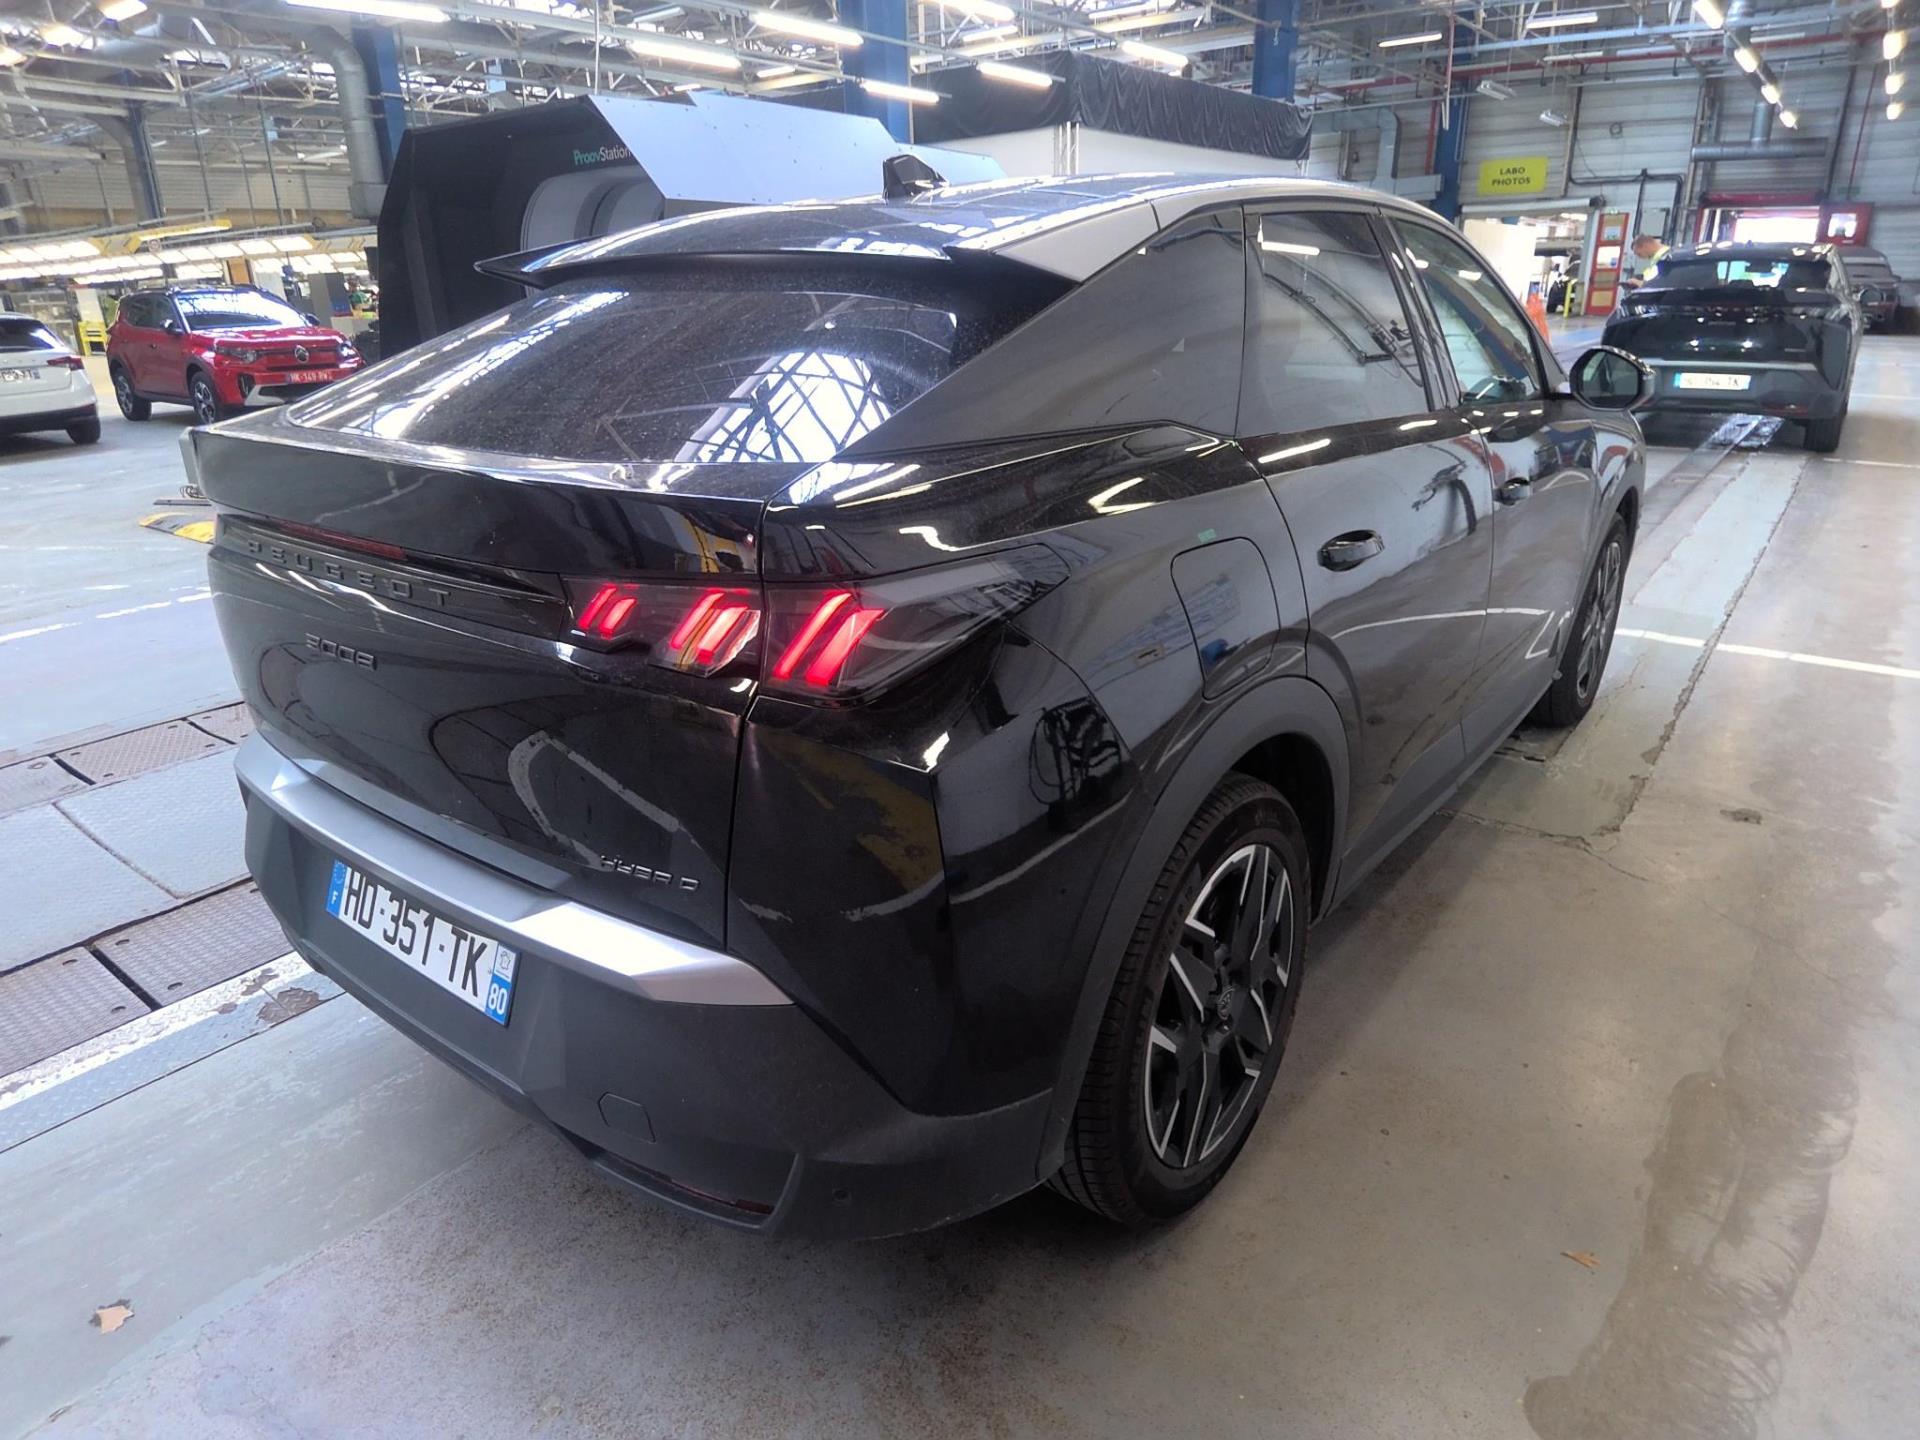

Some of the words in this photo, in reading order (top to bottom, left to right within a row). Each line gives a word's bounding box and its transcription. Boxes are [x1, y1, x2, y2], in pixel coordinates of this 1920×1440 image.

[1491, 177, 1531, 186] PHOTOS
[1499, 167, 1526, 175] LABO
[248, 540, 451, 606] PEUGEOT
[306, 633, 378, 671] 3008
[600, 855, 700, 891] HYBRD
[331, 891, 339, 905] F
[488, 983, 507, 1015] 80
